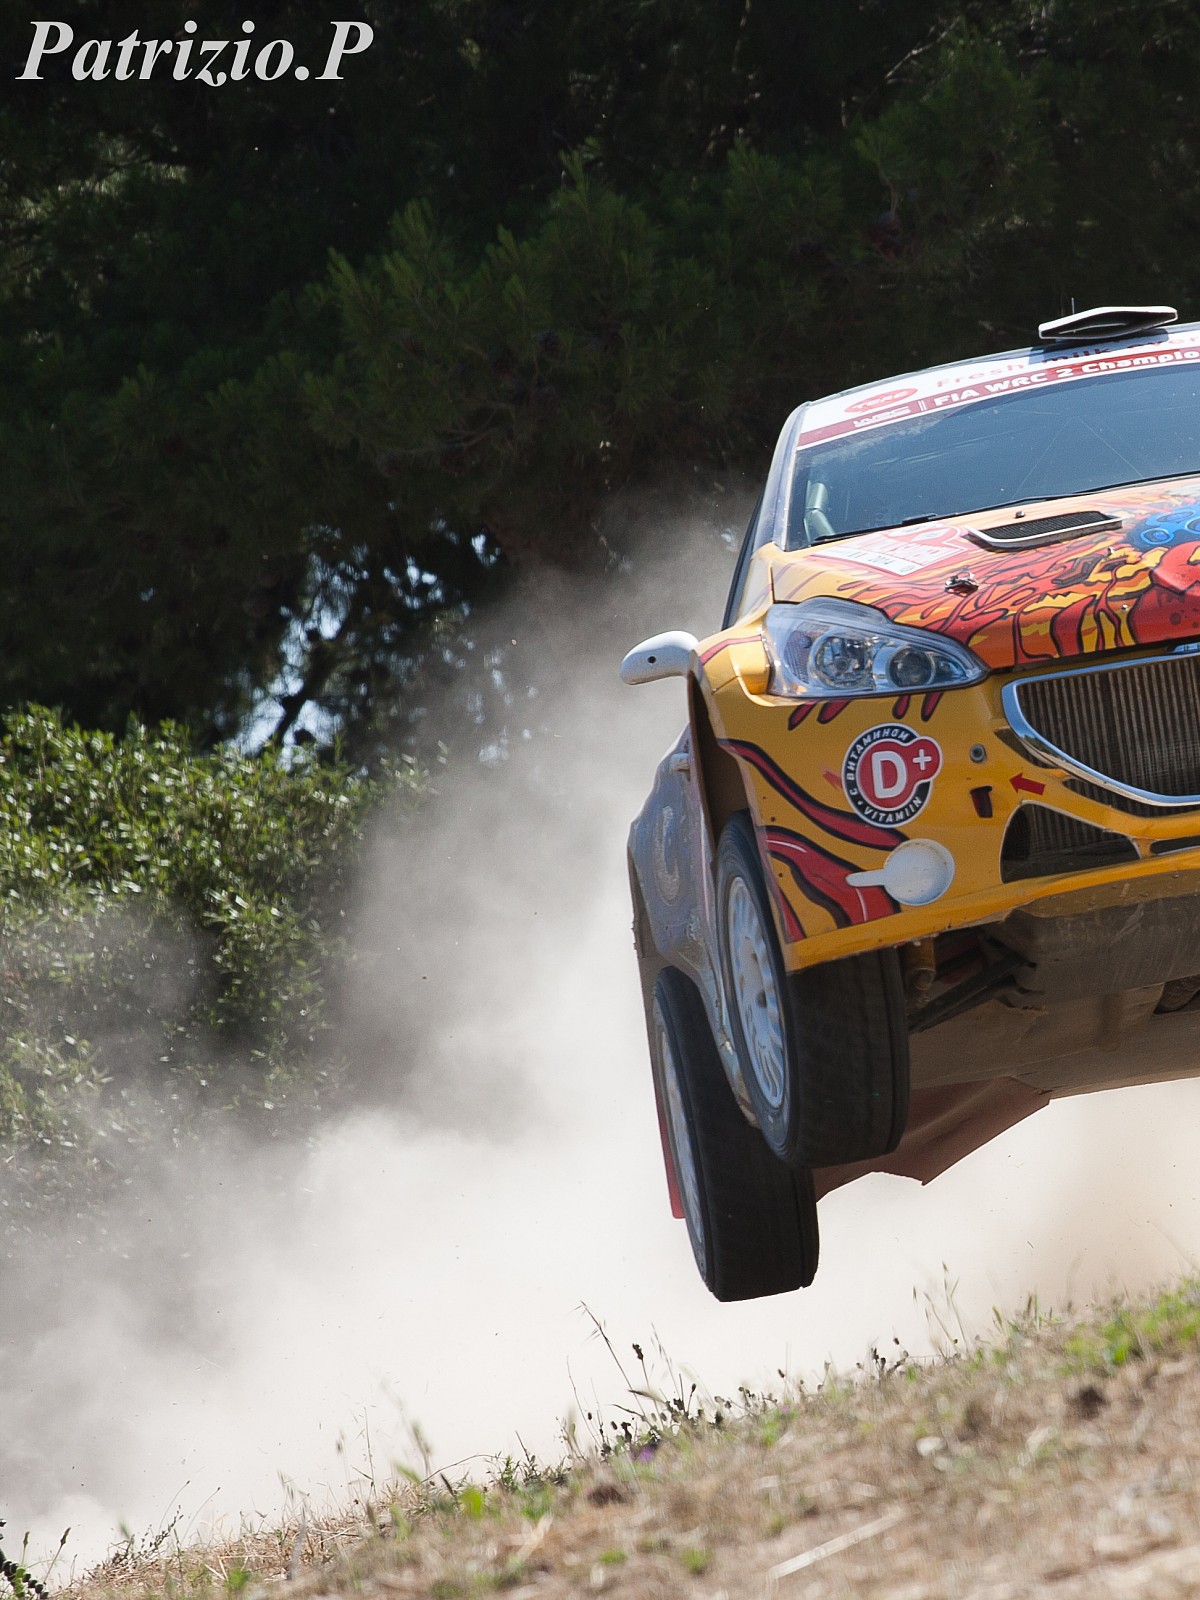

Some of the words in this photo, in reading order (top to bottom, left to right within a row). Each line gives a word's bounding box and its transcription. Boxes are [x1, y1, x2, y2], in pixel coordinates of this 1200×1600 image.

[933, 389, 980, 406] FIA
[984, 372, 1048, 394] WRC
[1055, 367, 1074, 379] 2
[936, 363, 1024, 387] Fresh
[864, 796, 923, 824] VITAMIIN
